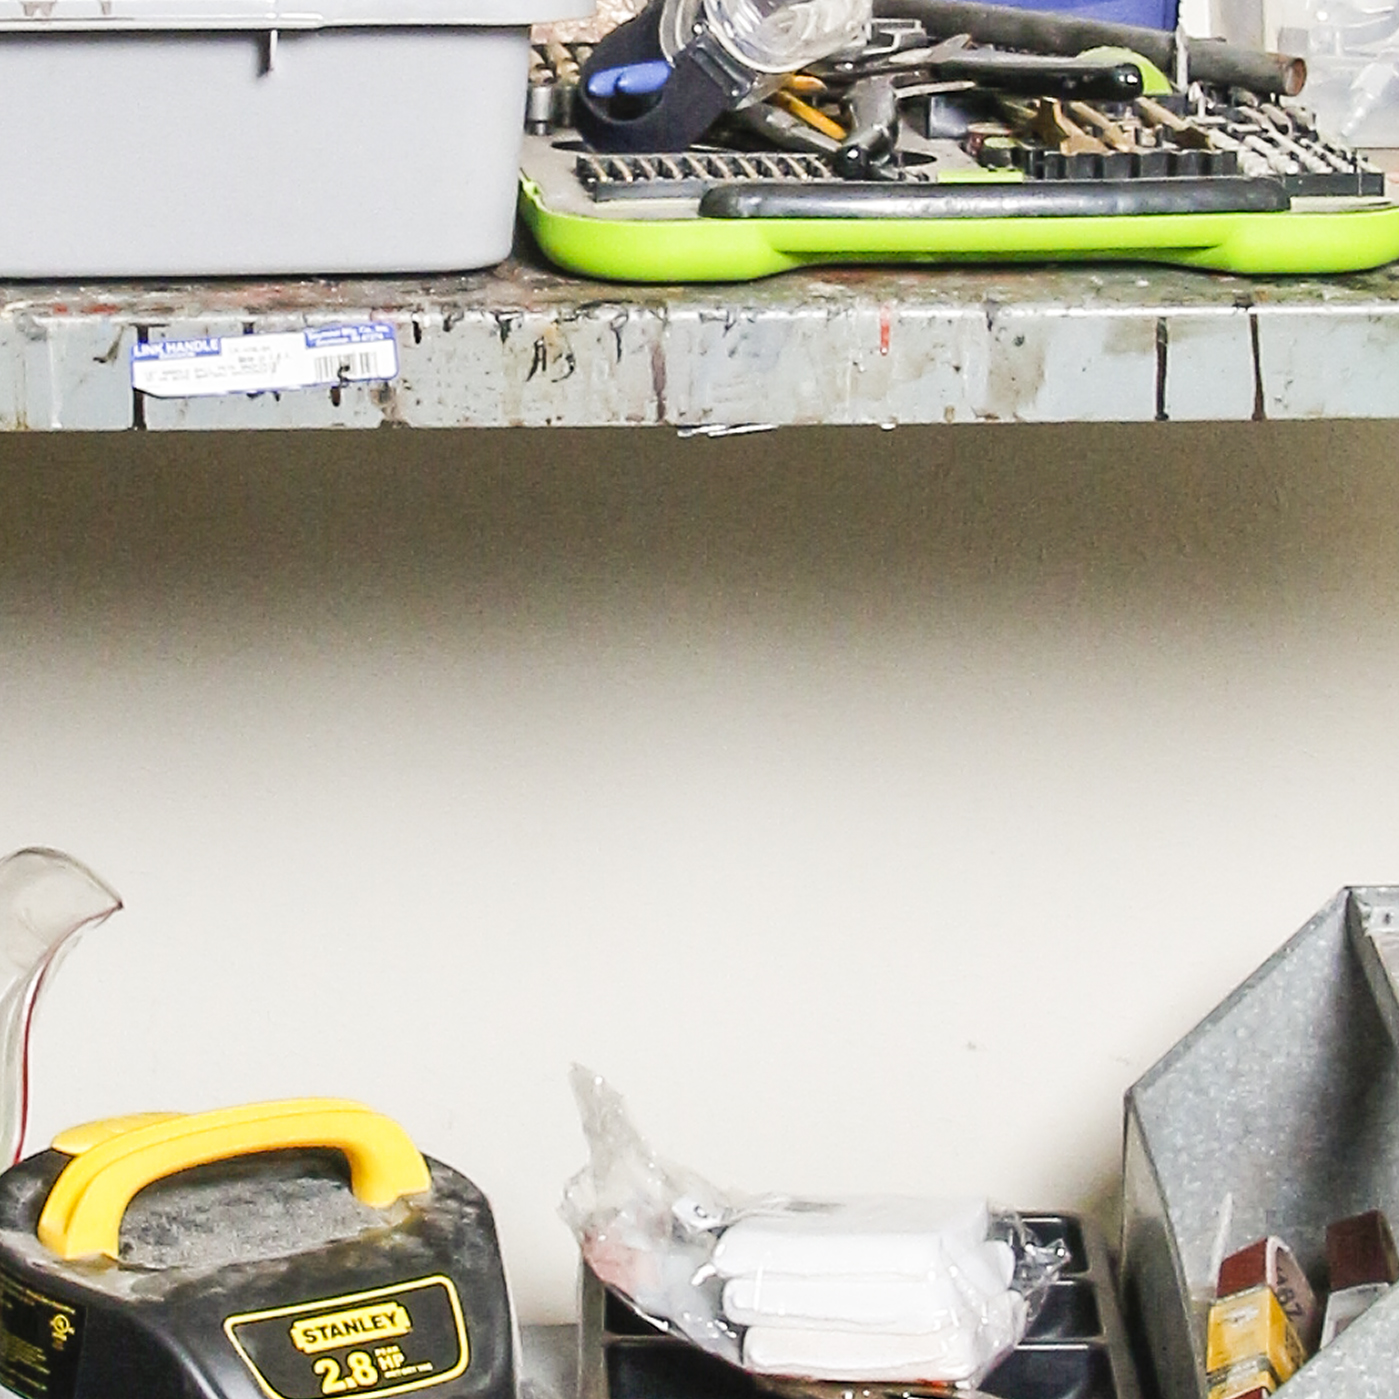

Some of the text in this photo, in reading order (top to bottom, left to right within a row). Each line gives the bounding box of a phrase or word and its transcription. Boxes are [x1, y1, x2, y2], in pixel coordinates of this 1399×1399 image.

[134, 343, 167, 357] LINK
[167, 339, 220, 353] HANDLE
[302, 1312, 397, 1343] STANLEY
[313, 1350, 379, 1395] 2.8
[377, 1353, 405, 1371] HP
